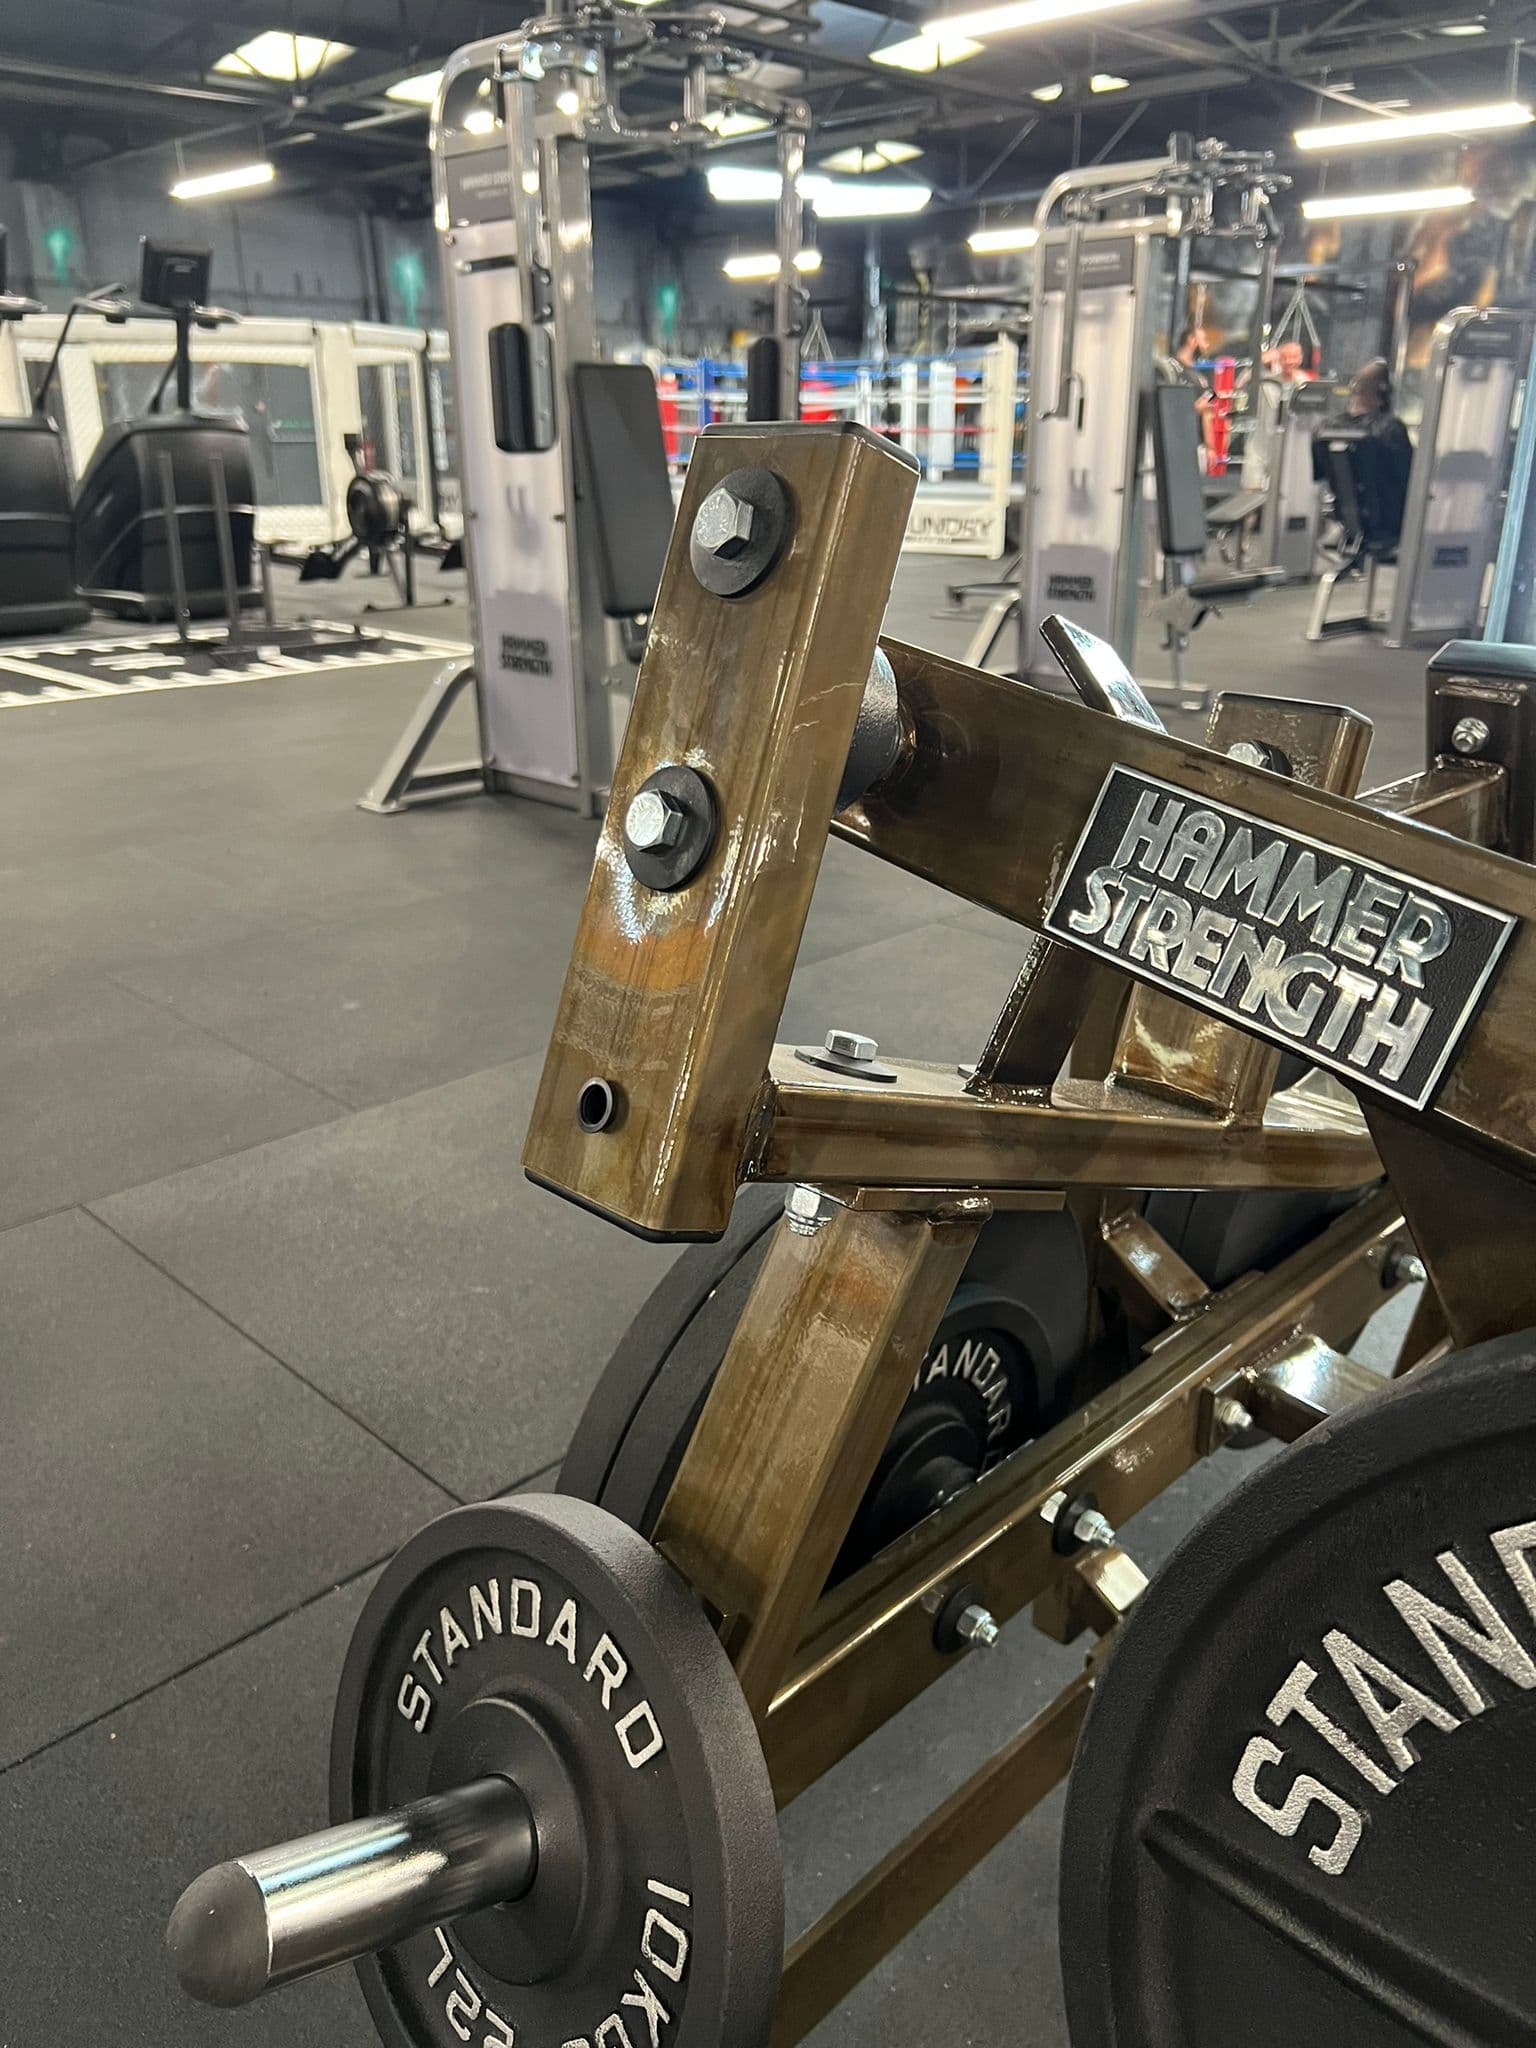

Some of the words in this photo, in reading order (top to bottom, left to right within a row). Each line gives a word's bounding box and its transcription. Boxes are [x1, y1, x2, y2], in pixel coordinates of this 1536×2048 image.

[909, 517, 993, 536] UNDRY
[1069, 865, 1436, 1082] STRENGTH
[1111, 790, 1454, 989] HAMMER
[397, 1577, 665, 1770] STANDARD
